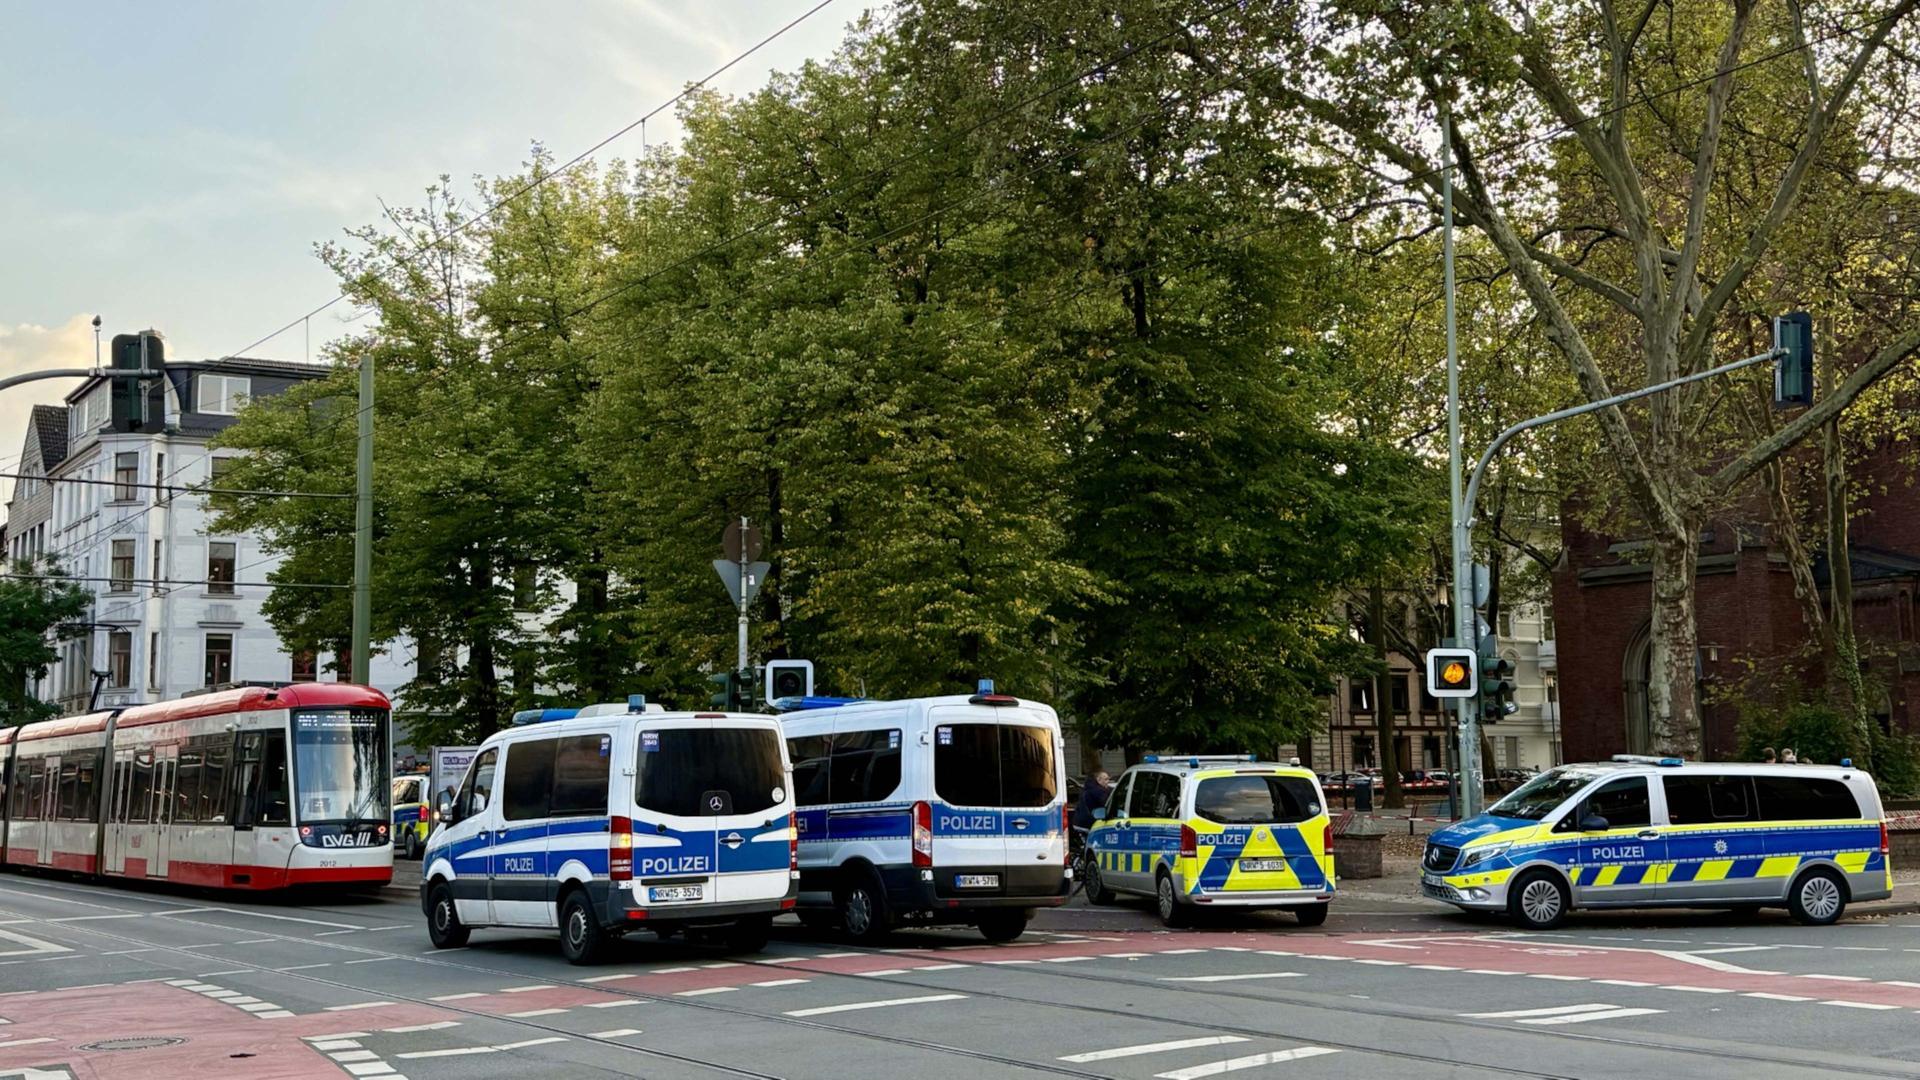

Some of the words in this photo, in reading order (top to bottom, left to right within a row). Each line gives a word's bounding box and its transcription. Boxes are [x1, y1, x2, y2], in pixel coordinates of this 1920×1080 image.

[941, 816, 996, 830] POLIZEI
[1197, 834, 1246, 845] POLIZEI
[1592, 846, 1645, 859] POLIZEI
[504, 857, 534, 872] POLIZEI
[642, 856, 709, 874] POLIZEI
